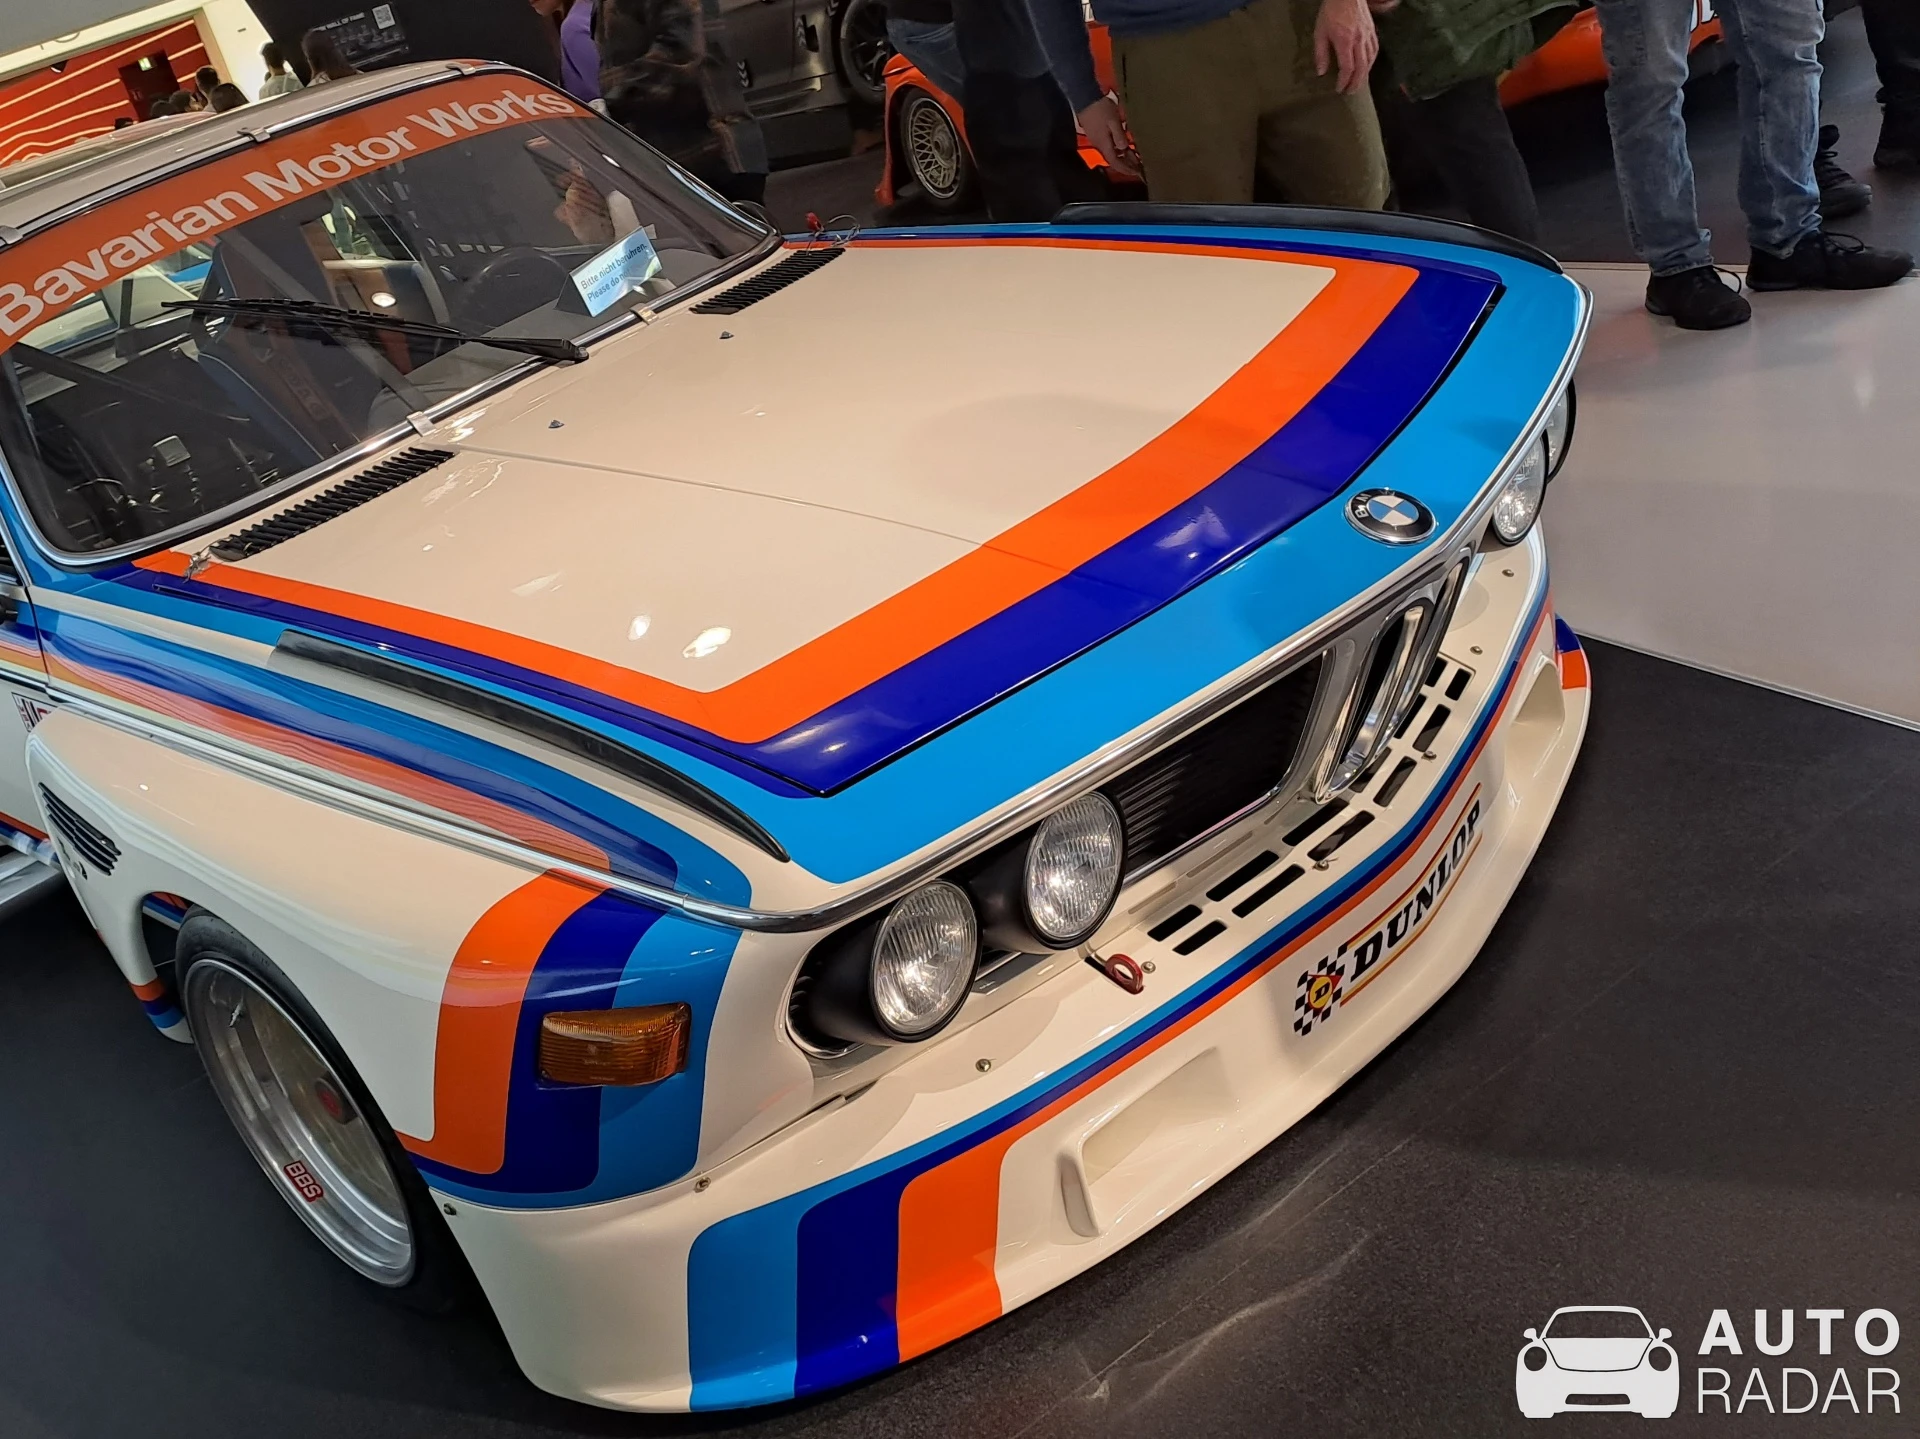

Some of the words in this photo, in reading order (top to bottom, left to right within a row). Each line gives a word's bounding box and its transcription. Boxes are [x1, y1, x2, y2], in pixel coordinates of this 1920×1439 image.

[349, 12, 365, 22] FAME
[0, 190, 259, 337] Bavarian
[242, 125, 417, 202] Motor
[407, 89, 575, 138] Works
[580, 274, 599, 290] Bitte
[599, 261, 616, 278] nicht
[587, 283, 610, 301] Please
[610, 276, 620, 287] do
[1350, 799, 1481, 983] DUNLOP
[286, 1162, 322, 1198] BBS
